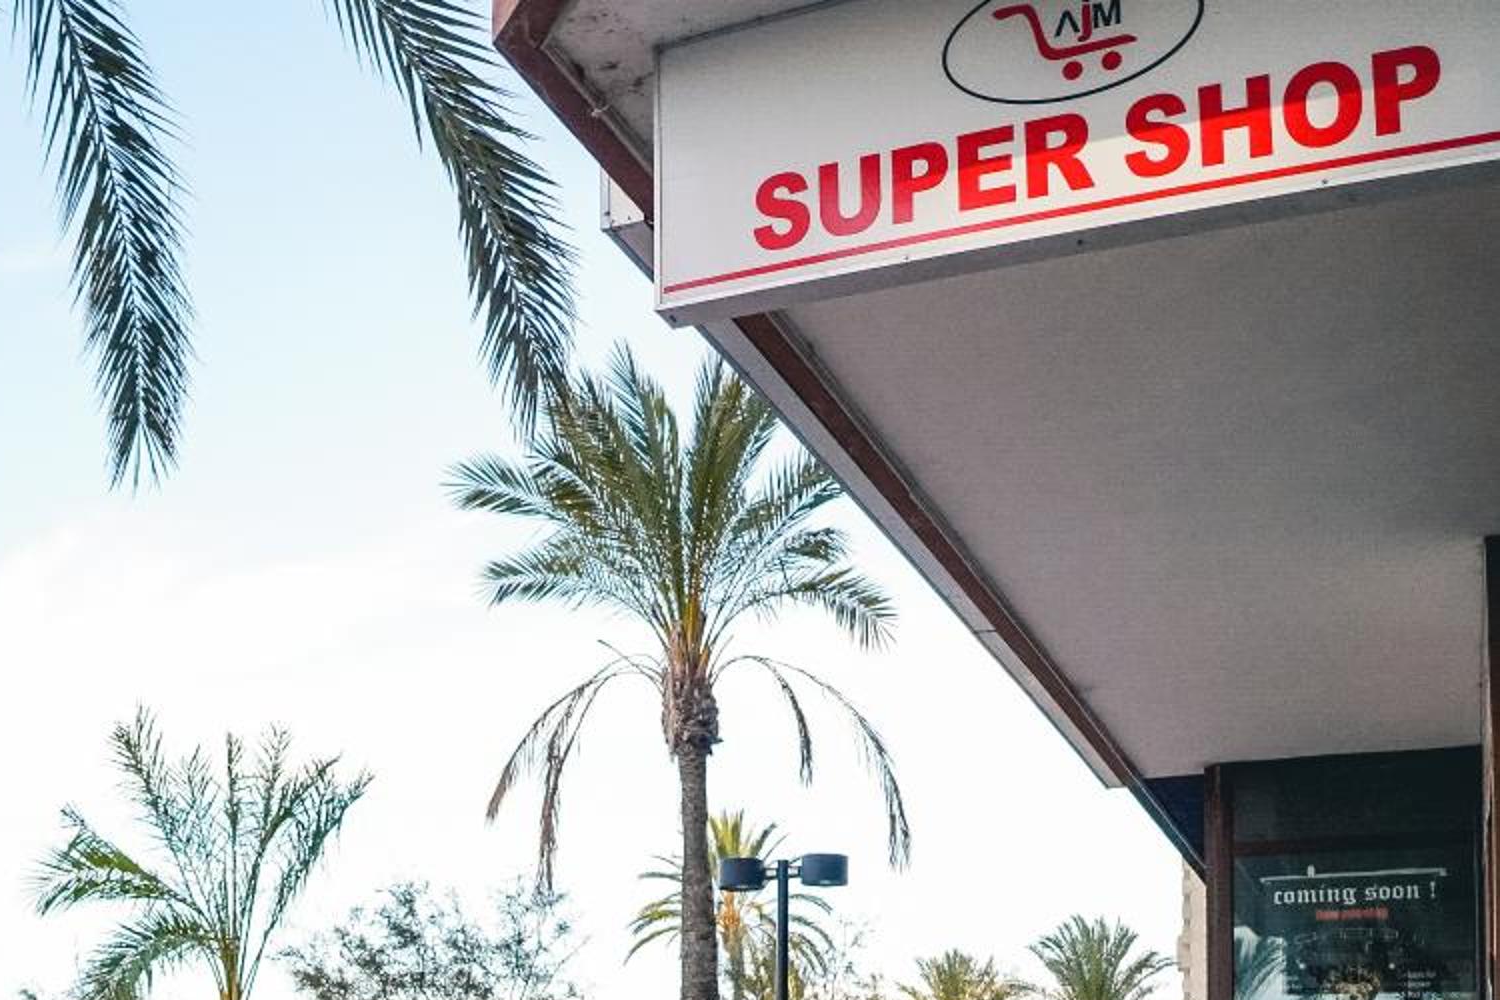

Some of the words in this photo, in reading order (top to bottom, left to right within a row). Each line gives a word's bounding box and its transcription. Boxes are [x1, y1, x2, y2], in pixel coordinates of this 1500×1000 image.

[753, 113, 1093, 251] SUPER
[1124, 45, 1442, 178] SHOP
[1273, 885, 1357, 905] coming
[1365, 883, 1421, 901] soon
